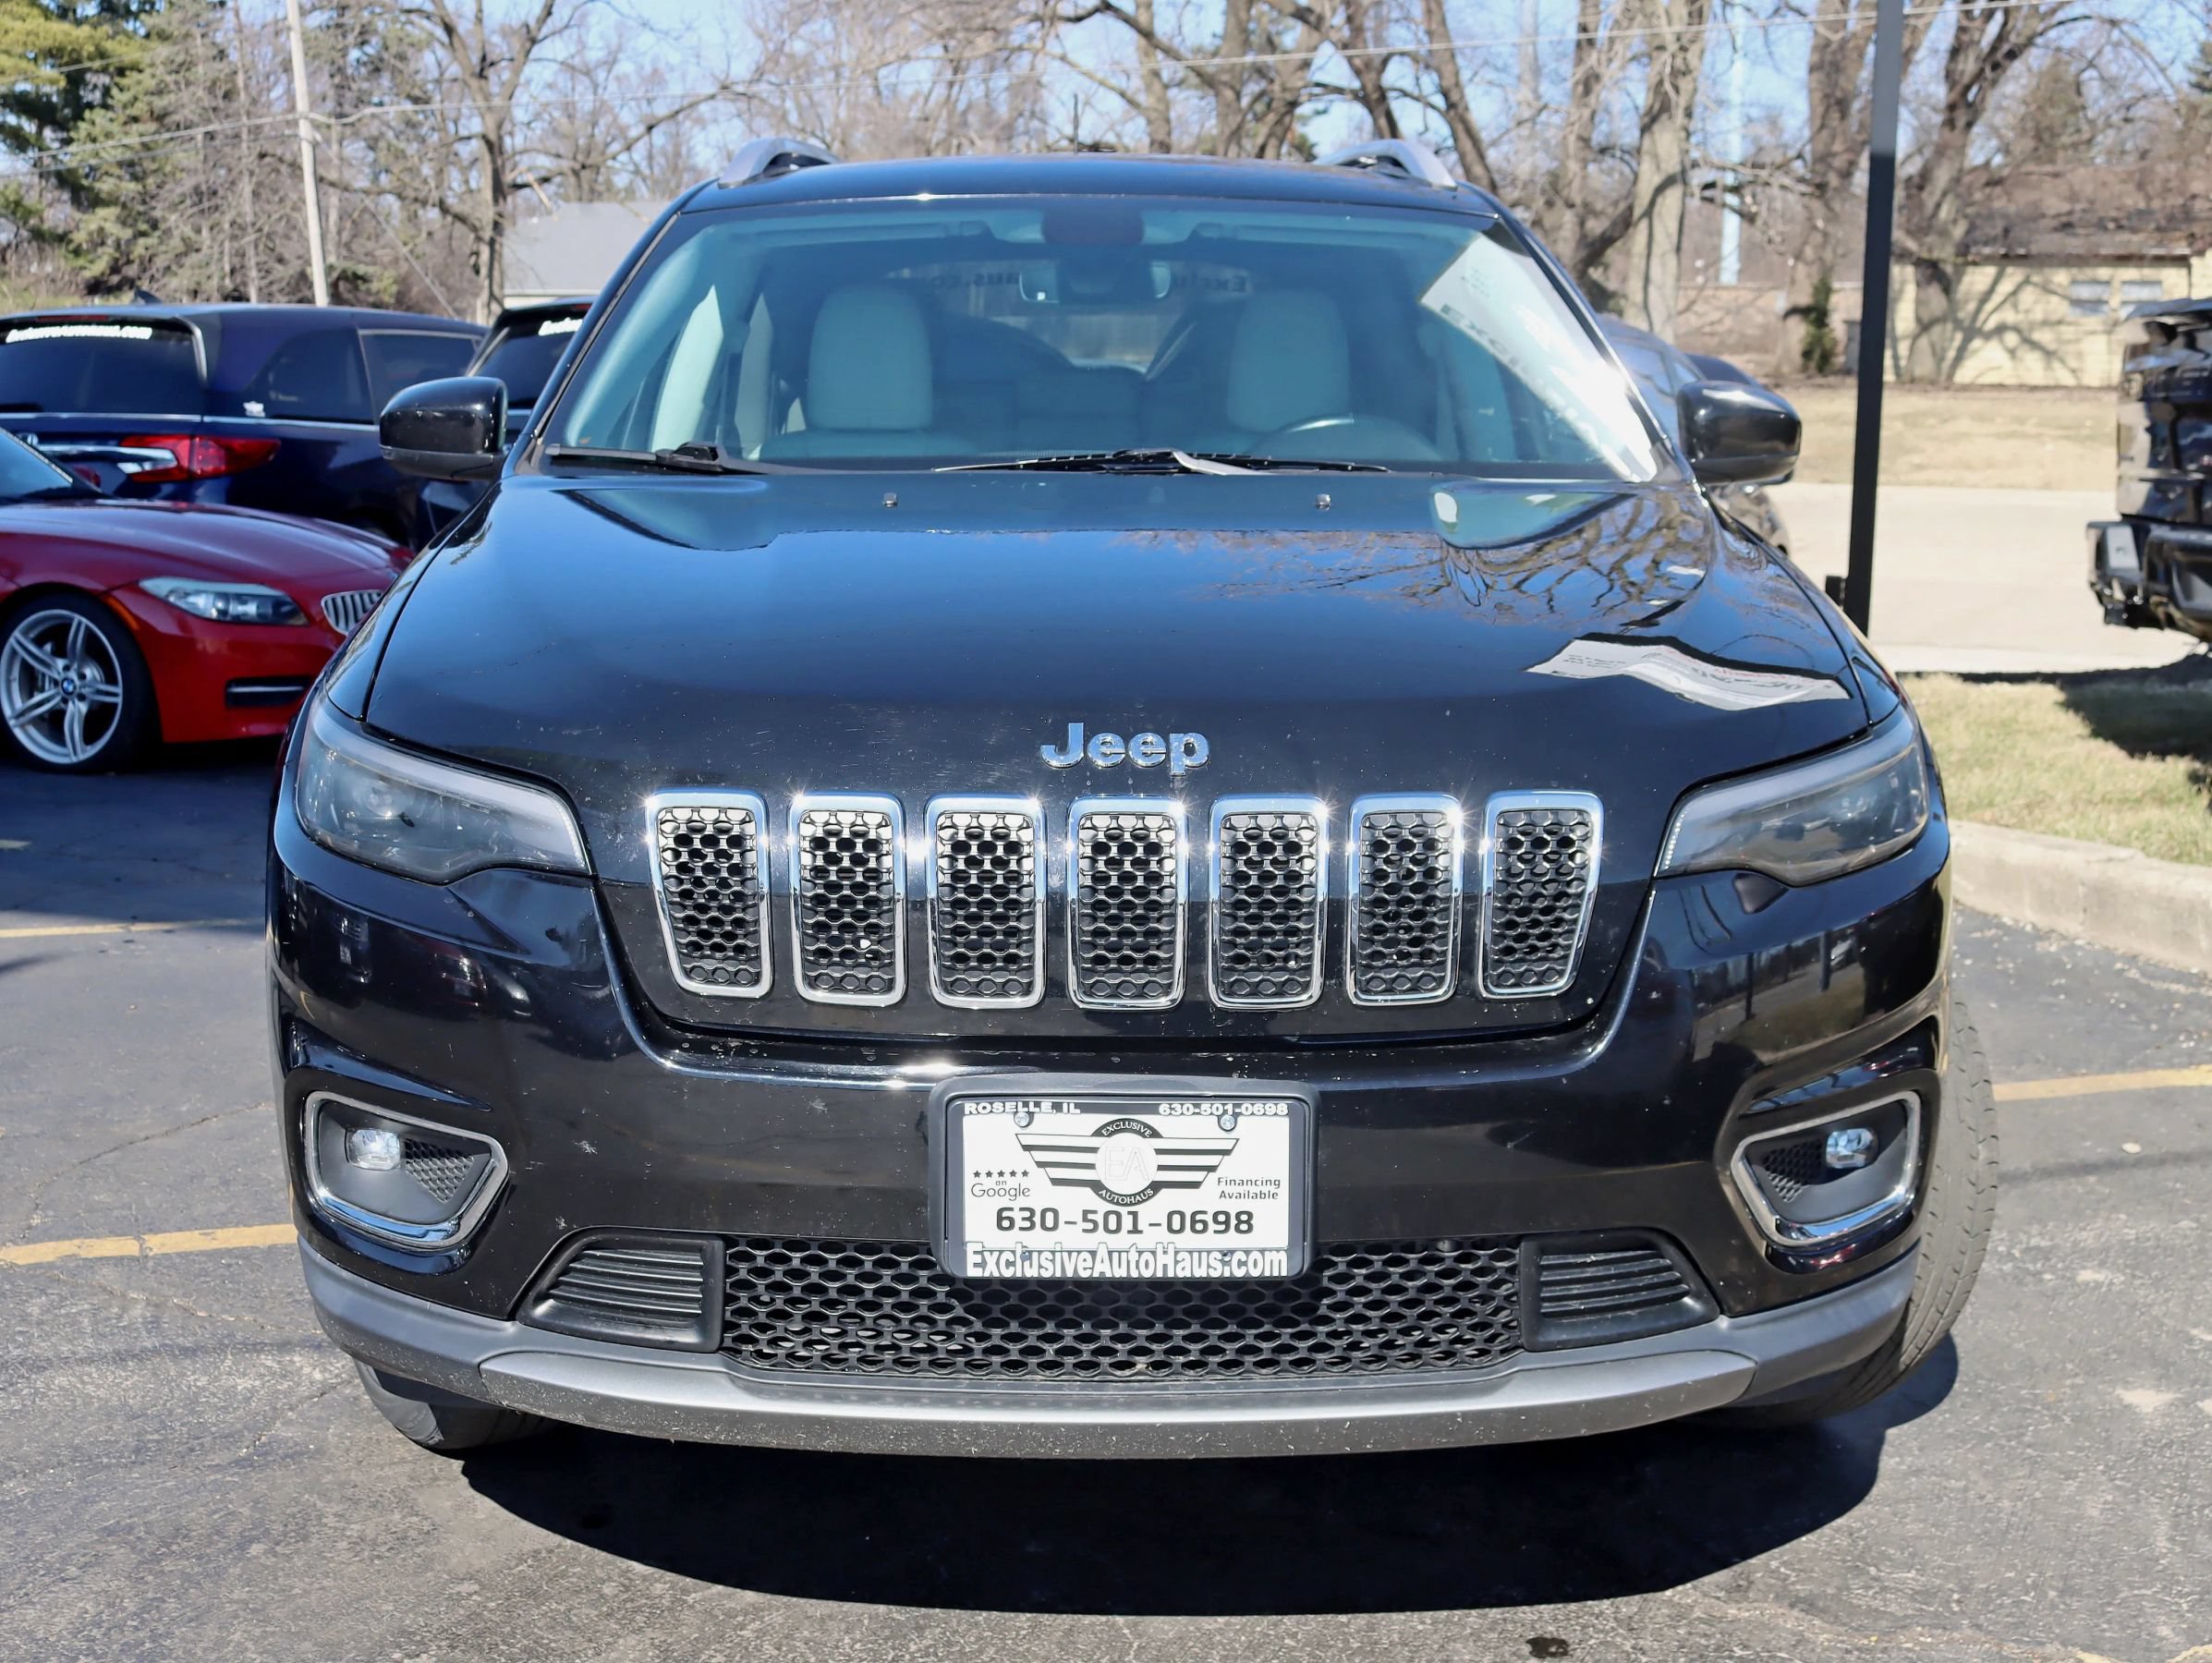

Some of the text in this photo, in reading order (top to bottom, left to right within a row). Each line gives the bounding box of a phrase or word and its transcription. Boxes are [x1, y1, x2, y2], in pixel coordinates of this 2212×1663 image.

[1040, 722, 1210, 775] Jeep
[965, 1101, 1081, 1115] ROSELLE, IL
[1159, 1102, 1289, 1116] 630-501-0698
[1101, 1121, 1153, 1138] EXCLUSIVE
[1104, 1146, 1150, 1181] EA
[1217, 1176, 1281, 1189] Financing
[970, 1183, 1031, 1202] Google
[1098, 1188, 1155, 1205] AUTOHAUS
[1219, 1189, 1279, 1199] Available
[995, 1207, 1255, 1235] 630-501-0698
[966, 1241, 1288, 1279] ExclusiveAutoHaus.com
